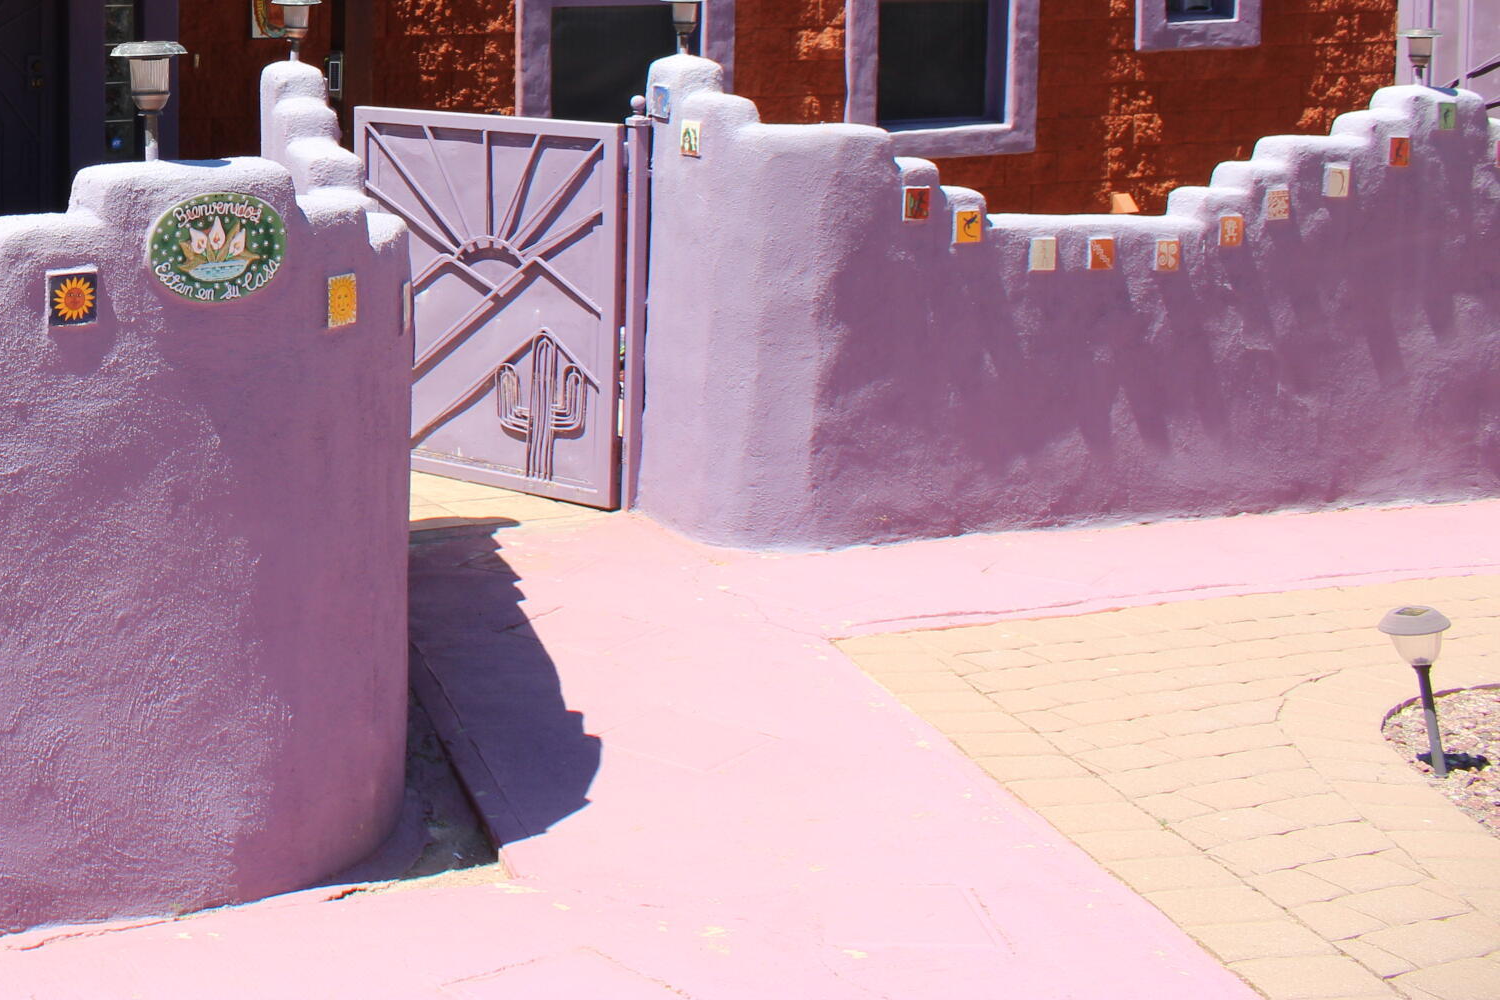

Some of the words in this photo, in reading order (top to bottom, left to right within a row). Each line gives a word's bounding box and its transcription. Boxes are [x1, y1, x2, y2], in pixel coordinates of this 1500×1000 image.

[173, 200, 262, 228] Bienvenidos
[195, 287, 214, 301] en
[220, 281, 241, 299] su
